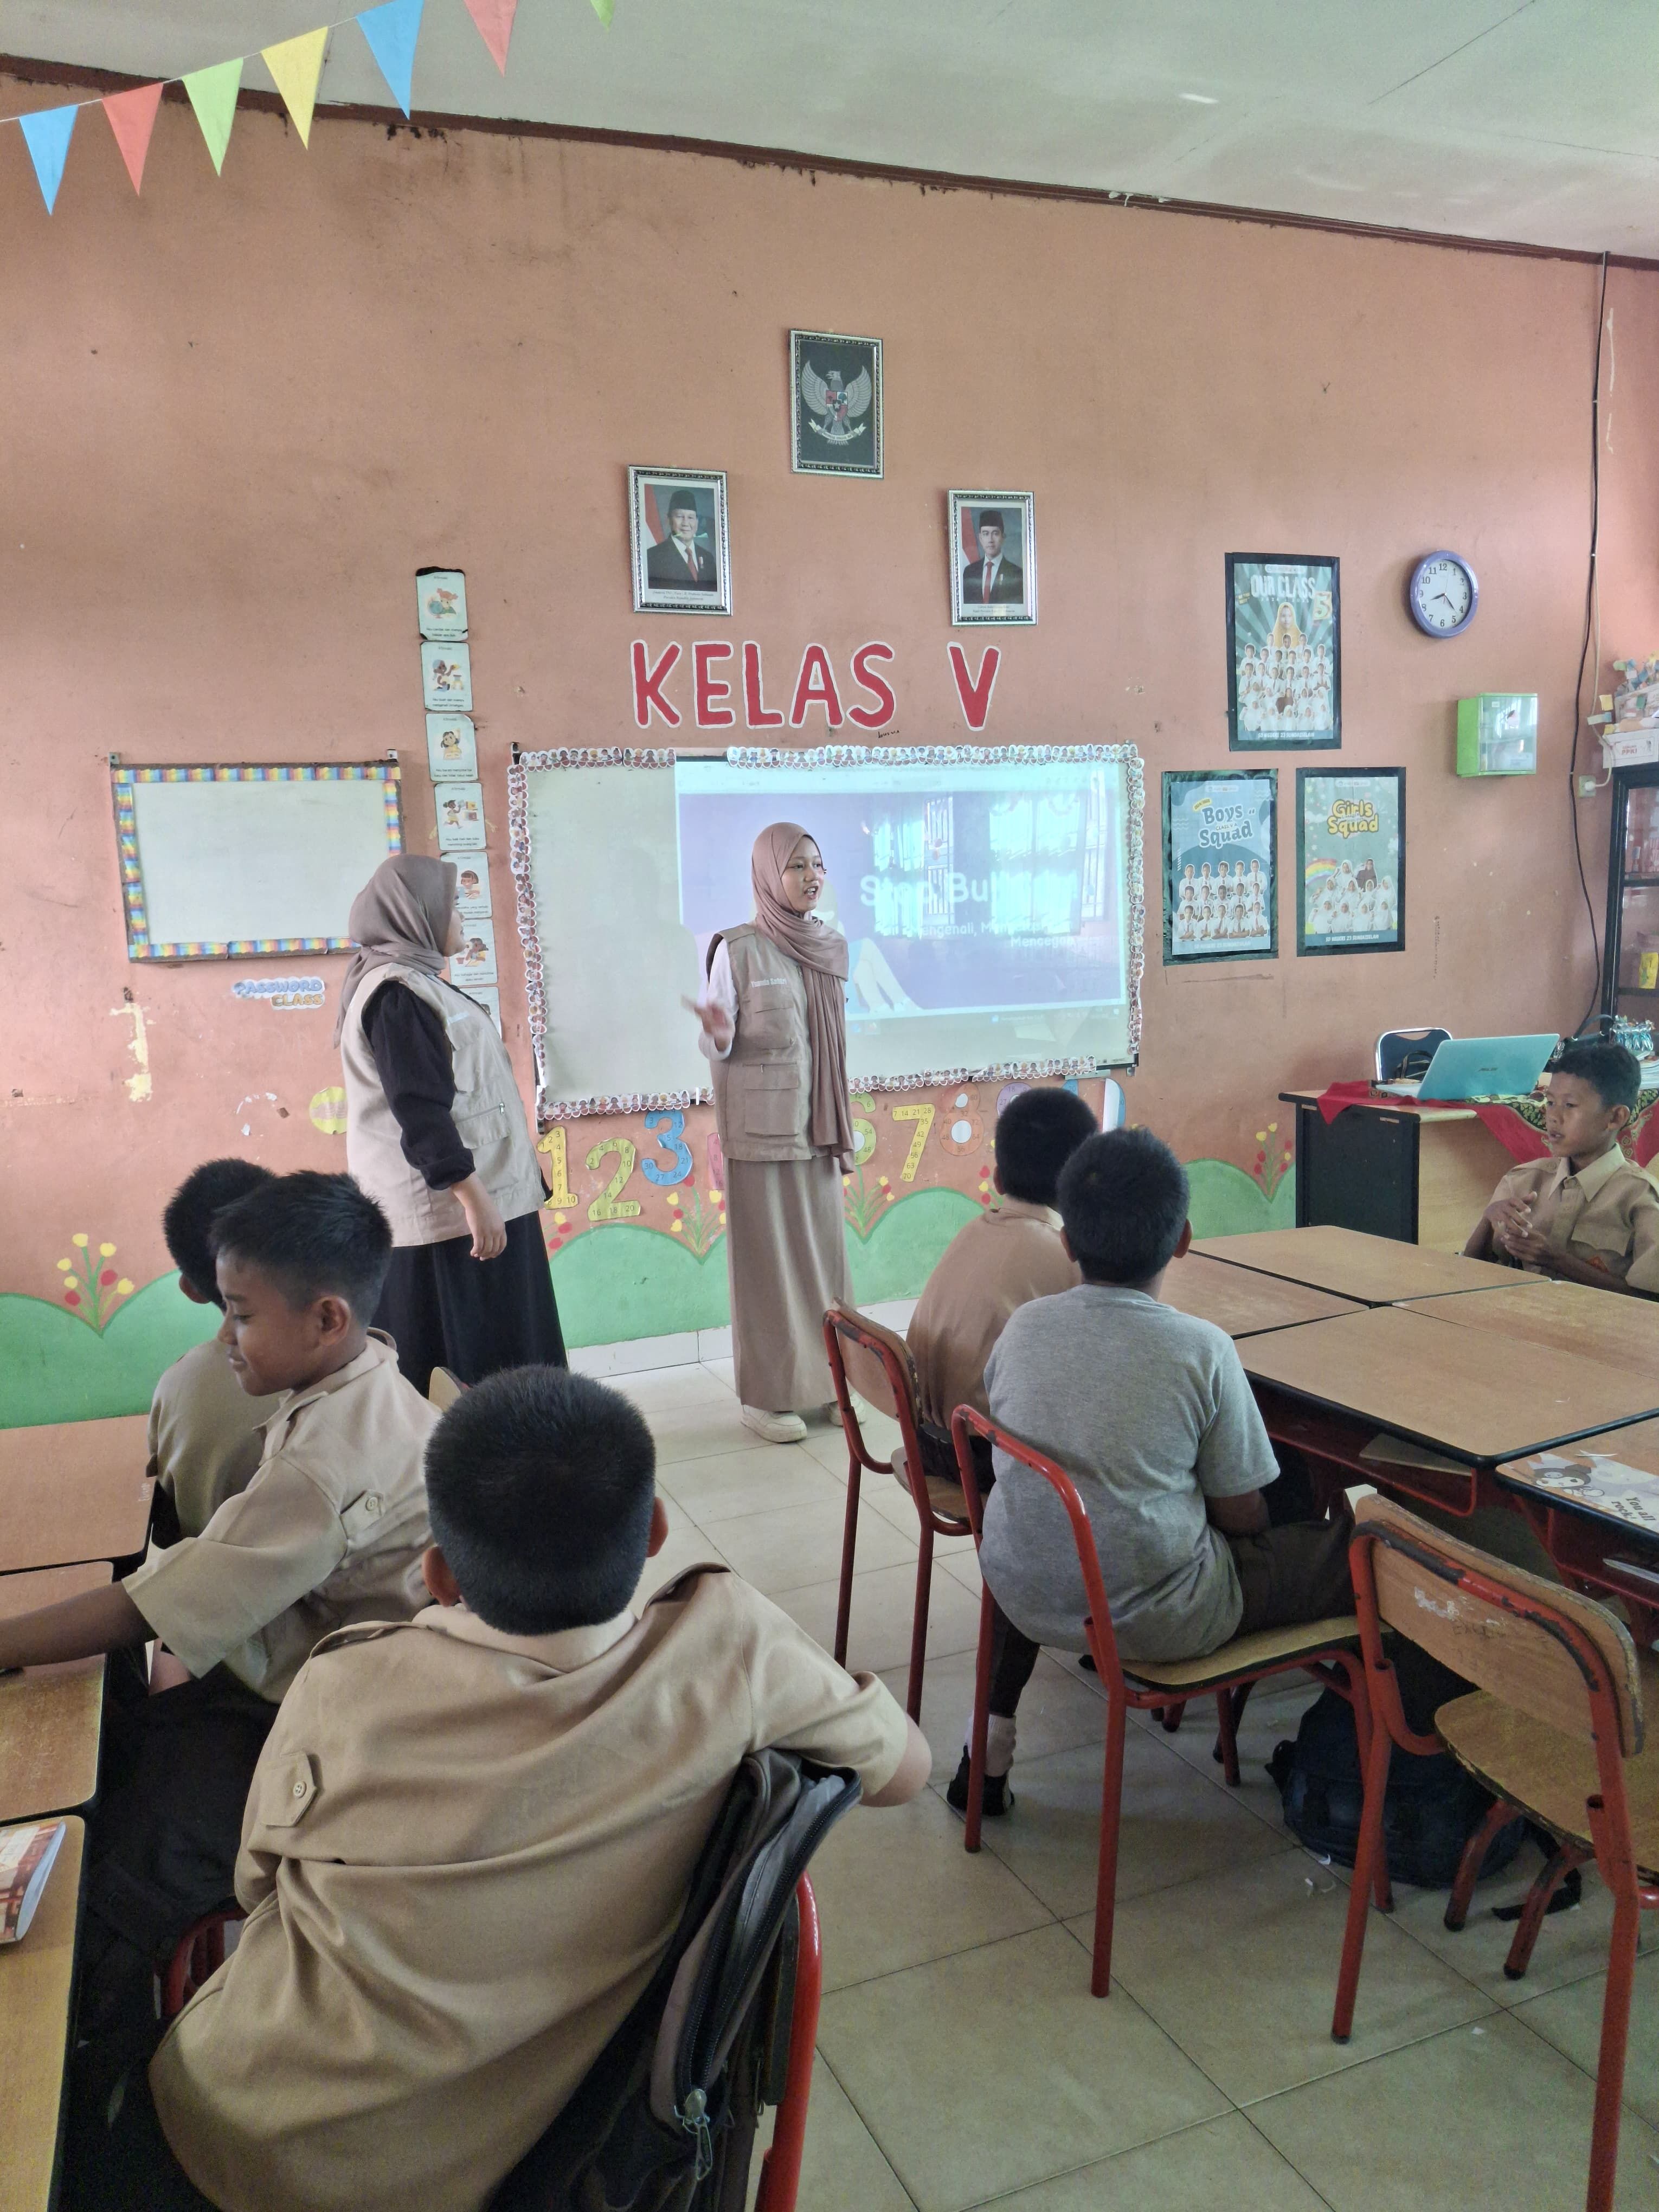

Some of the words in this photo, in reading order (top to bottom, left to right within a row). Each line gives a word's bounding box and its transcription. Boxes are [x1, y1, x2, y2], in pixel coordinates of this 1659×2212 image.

[1250, 575, 1275, 597] OUR
[1277, 576, 1315, 599] CLASS
[1422, 603, 1427, 612] 8
[630, 639, 896, 730] KELAS
[947, 641, 1001, 731] V
[1201, 805, 1243, 824] Boys
[1332, 799, 1373, 818] Girls
[1199, 820, 1253, 847] Squad
[1327, 813, 1379, 839] Squad
[234, 980, 322, 994] PASSWORD
[271, 993, 323, 1006] CLASS
[1611, 1501, 1637, 1519] rock!
[1625, 1497, 1643, 1510] You
[1638, 1512, 1657, 1521] all
